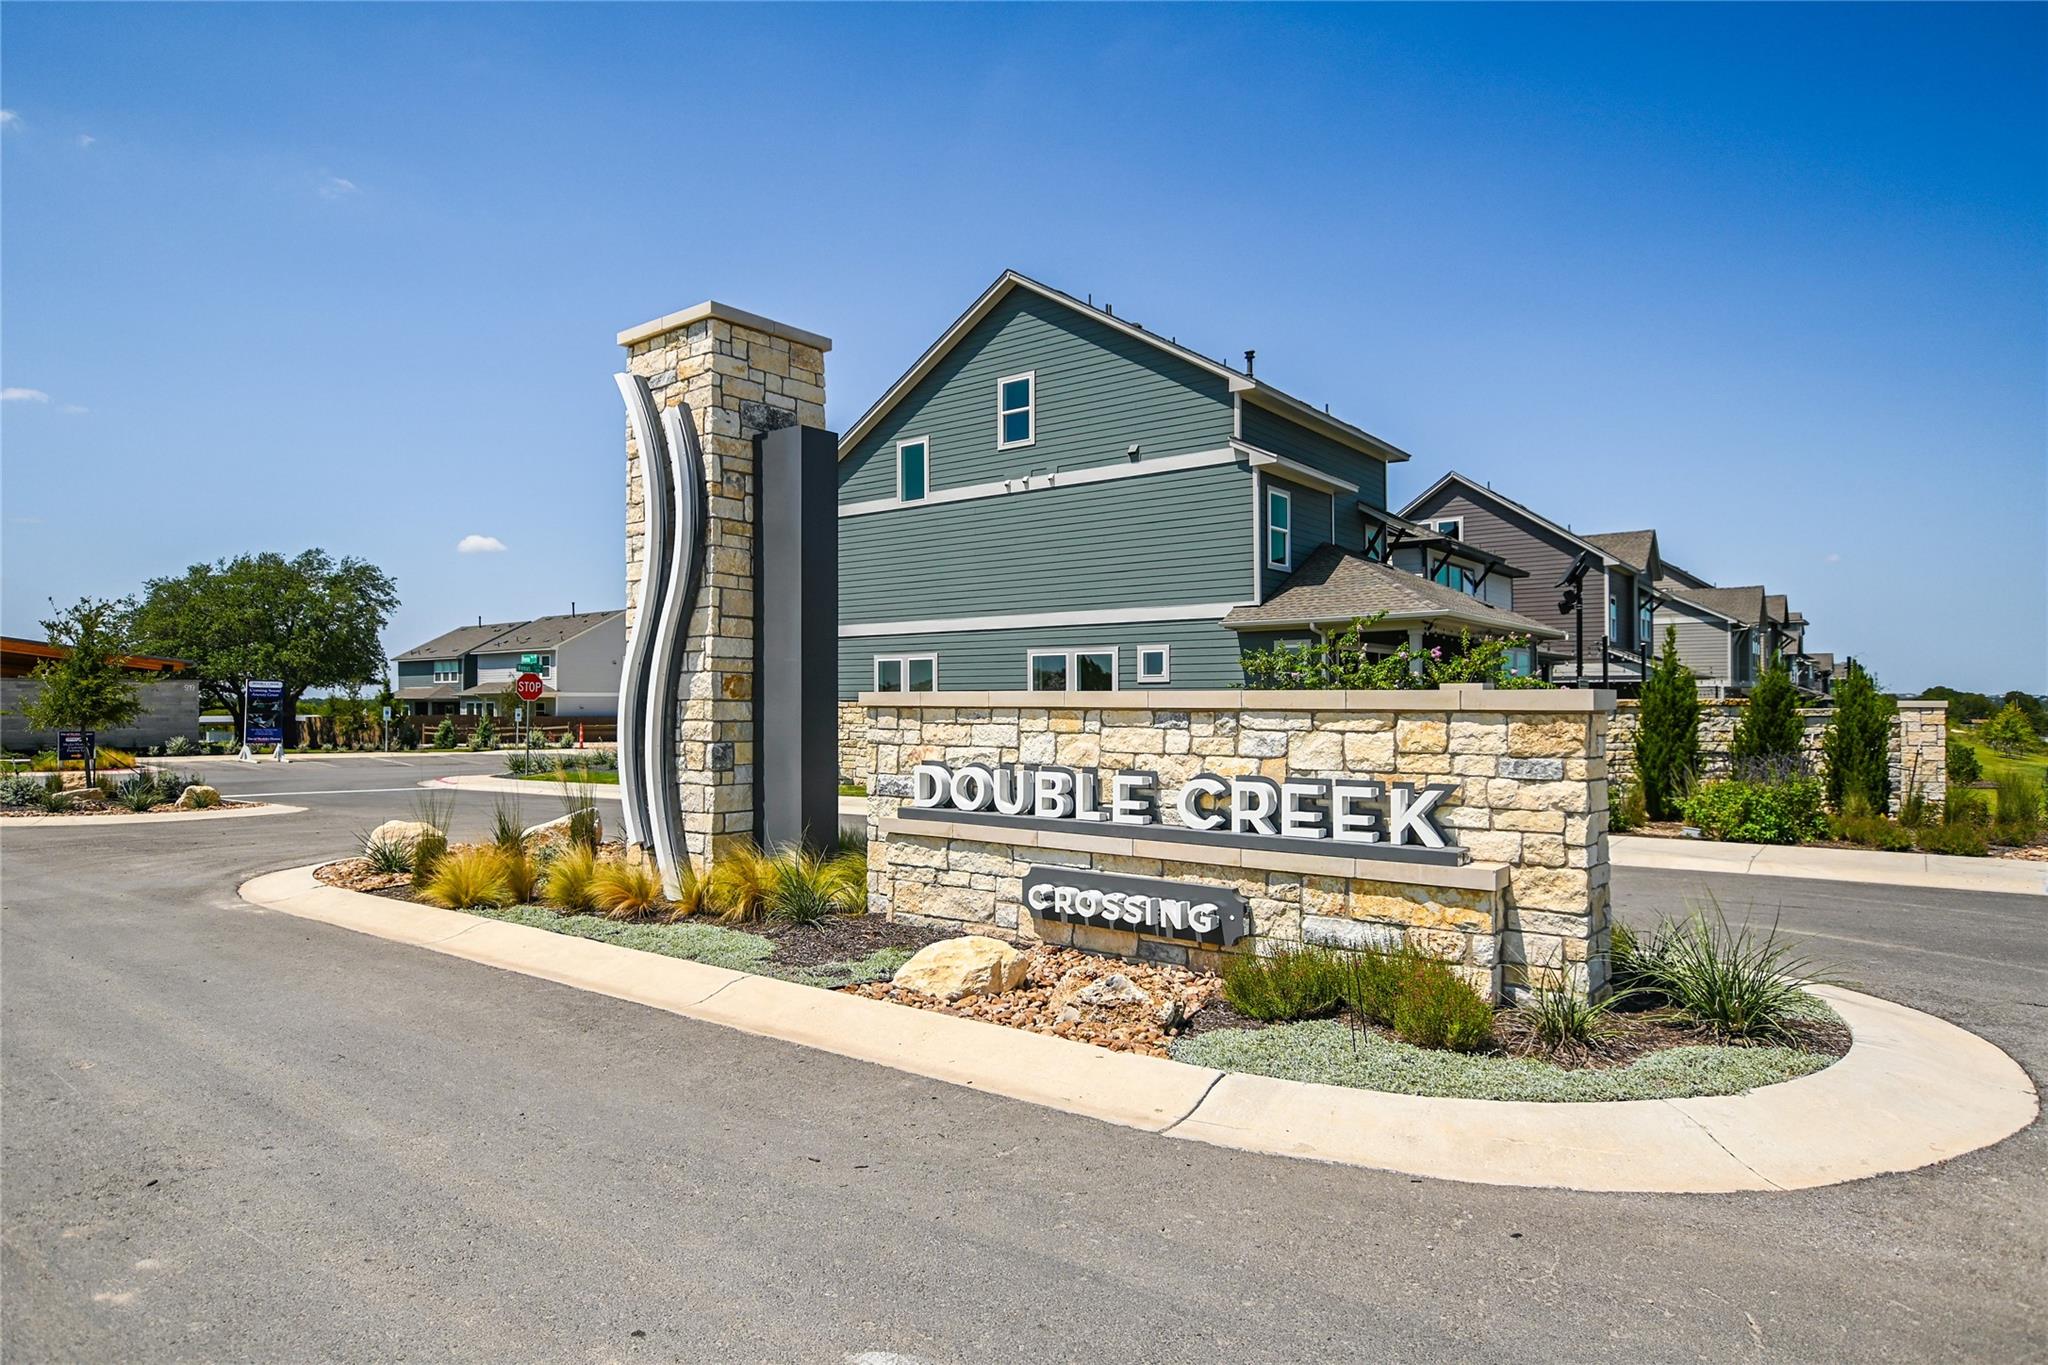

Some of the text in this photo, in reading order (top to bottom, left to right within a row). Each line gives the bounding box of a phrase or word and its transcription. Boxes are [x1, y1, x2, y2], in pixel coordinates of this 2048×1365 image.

[518, 681, 541, 692] STOP
[913, 764, 1446, 848] DOUBLE CREEK
[1028, 884, 1219, 933] CROSSING
